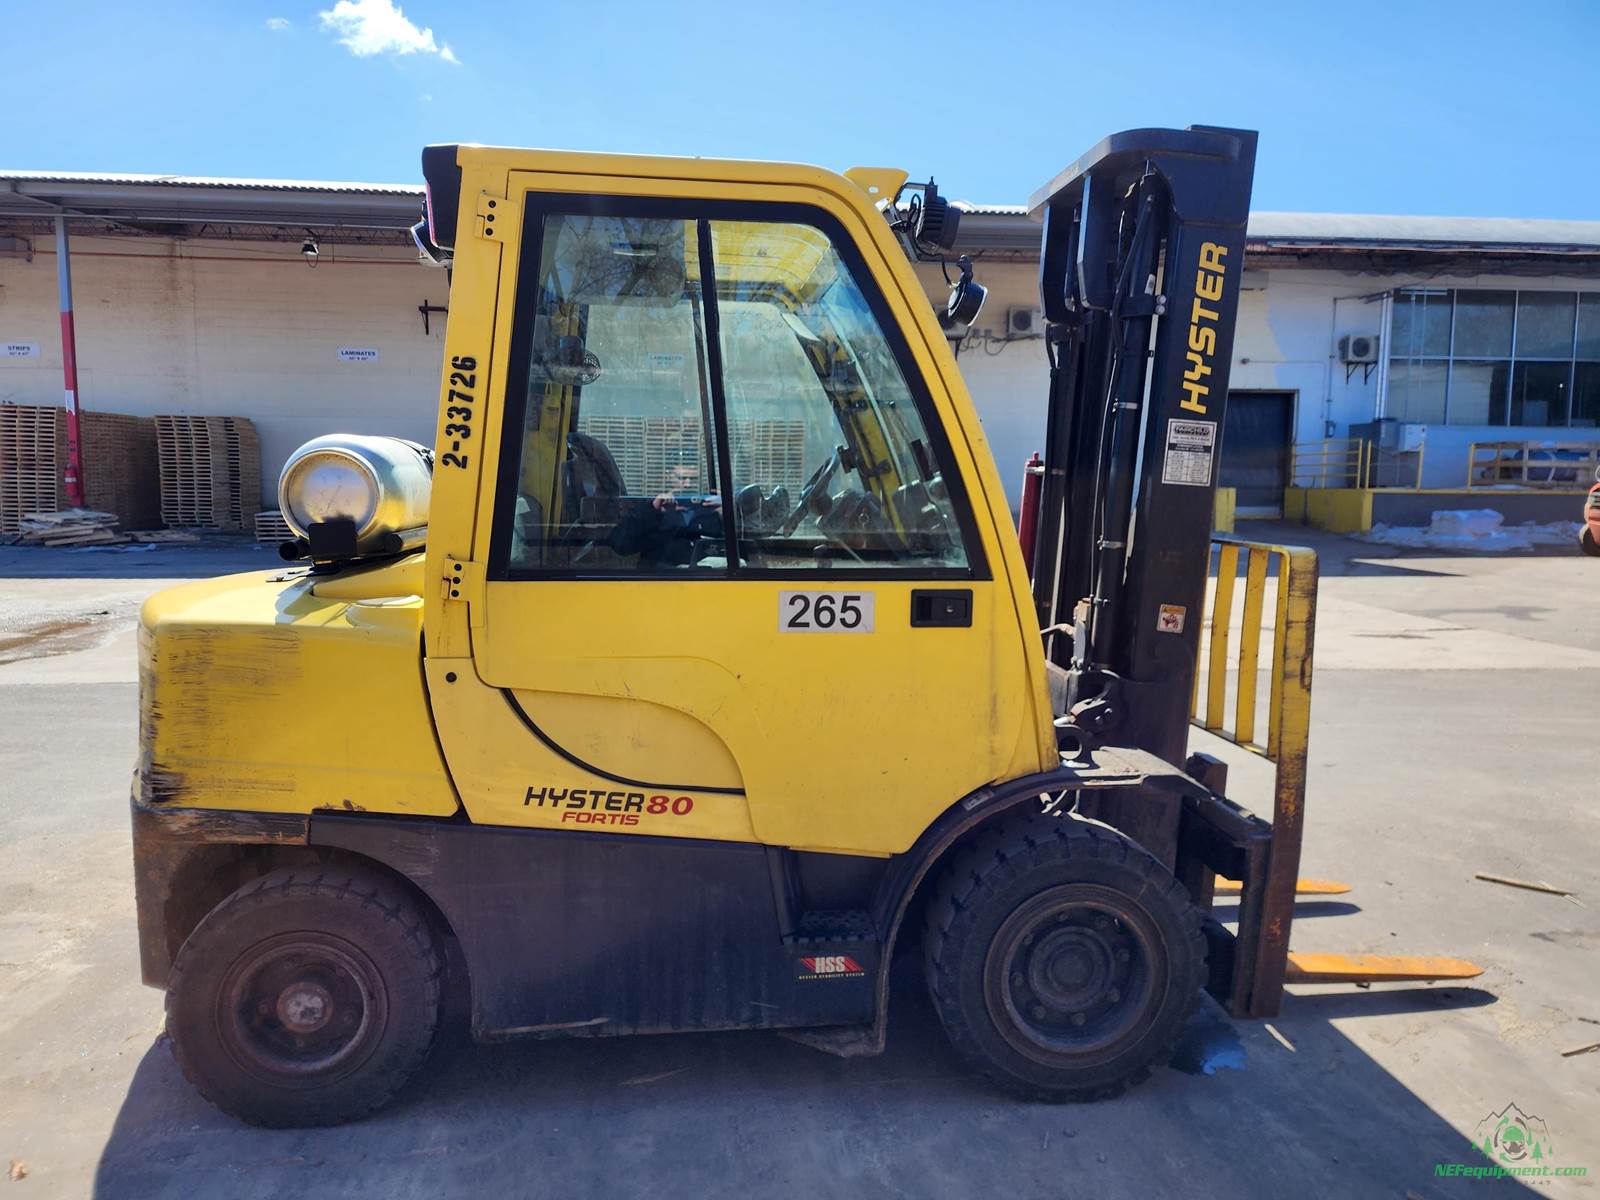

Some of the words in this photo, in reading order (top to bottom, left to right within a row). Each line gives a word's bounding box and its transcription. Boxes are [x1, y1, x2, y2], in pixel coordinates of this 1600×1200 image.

[1180, 241, 1228, 414] HYSTER
[442, 356, 477, 469] 2-33726
[787, 594, 862, 629] 265
[523, 786, 645, 813] HYSTER
[646, 795, 694, 816] 80
[561, 811, 640, 826] FORTIS
